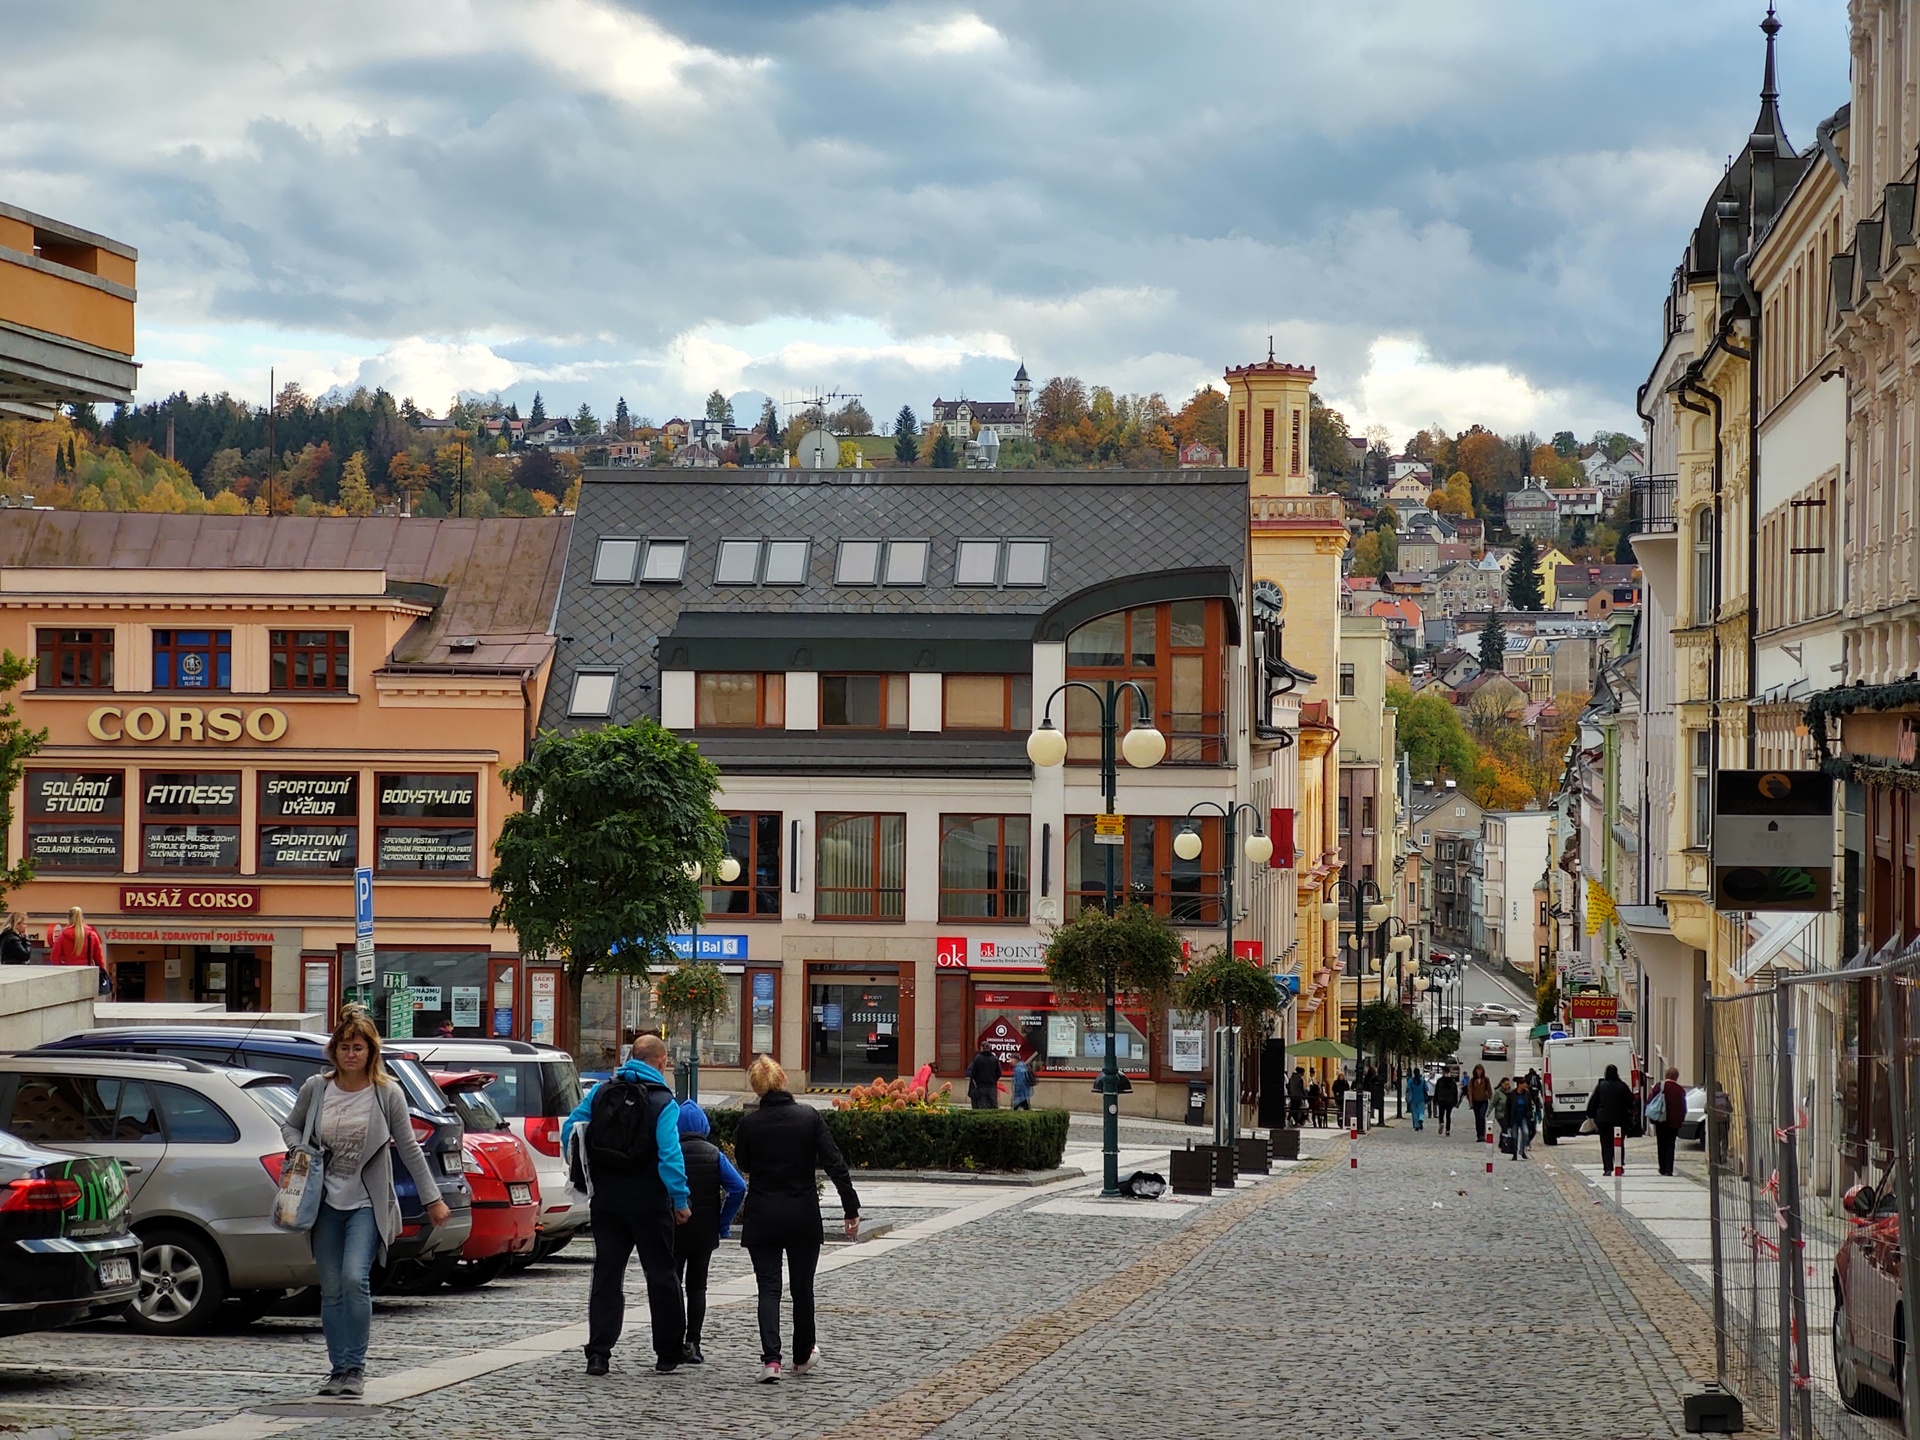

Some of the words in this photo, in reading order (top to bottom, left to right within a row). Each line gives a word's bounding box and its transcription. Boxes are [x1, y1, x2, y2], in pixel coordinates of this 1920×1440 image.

[87, 706, 289, 742] CORSO
[41, 776, 113, 796] SOLÁRNÍ
[267, 777, 352, 795] SPORTOVNÍ
[147, 785, 237, 805] FITNESS
[381, 789, 473, 805] BODYSTYLING
[45, 798, 105, 813] STUDIO
[270, 833, 347, 846] SPORTOVNÍ
[71, 846, 116, 854] KOSMETIKA
[276, 849, 341, 863] OBLEČENÍ
[125, 889, 183, 907] PASÁŽ
[188, 892, 253, 908] CORSO
[359, 877, 369, 915] P
[104, 929, 159, 941] VŠEOBECNÁ
[161, 930, 214, 941] ZDRAVOTNÍ
[217, 931, 275, 943] POJIŠŤOVNA
[702, 941, 721, 953] Bal
[981, 945, 994, 958] ok
[996, 946, 1039, 958] POINT
[937, 944, 966, 967] ok
[1594, 1008, 1616, 1016] FOTO
[988, 1043, 1022, 1052] POTÉKY
